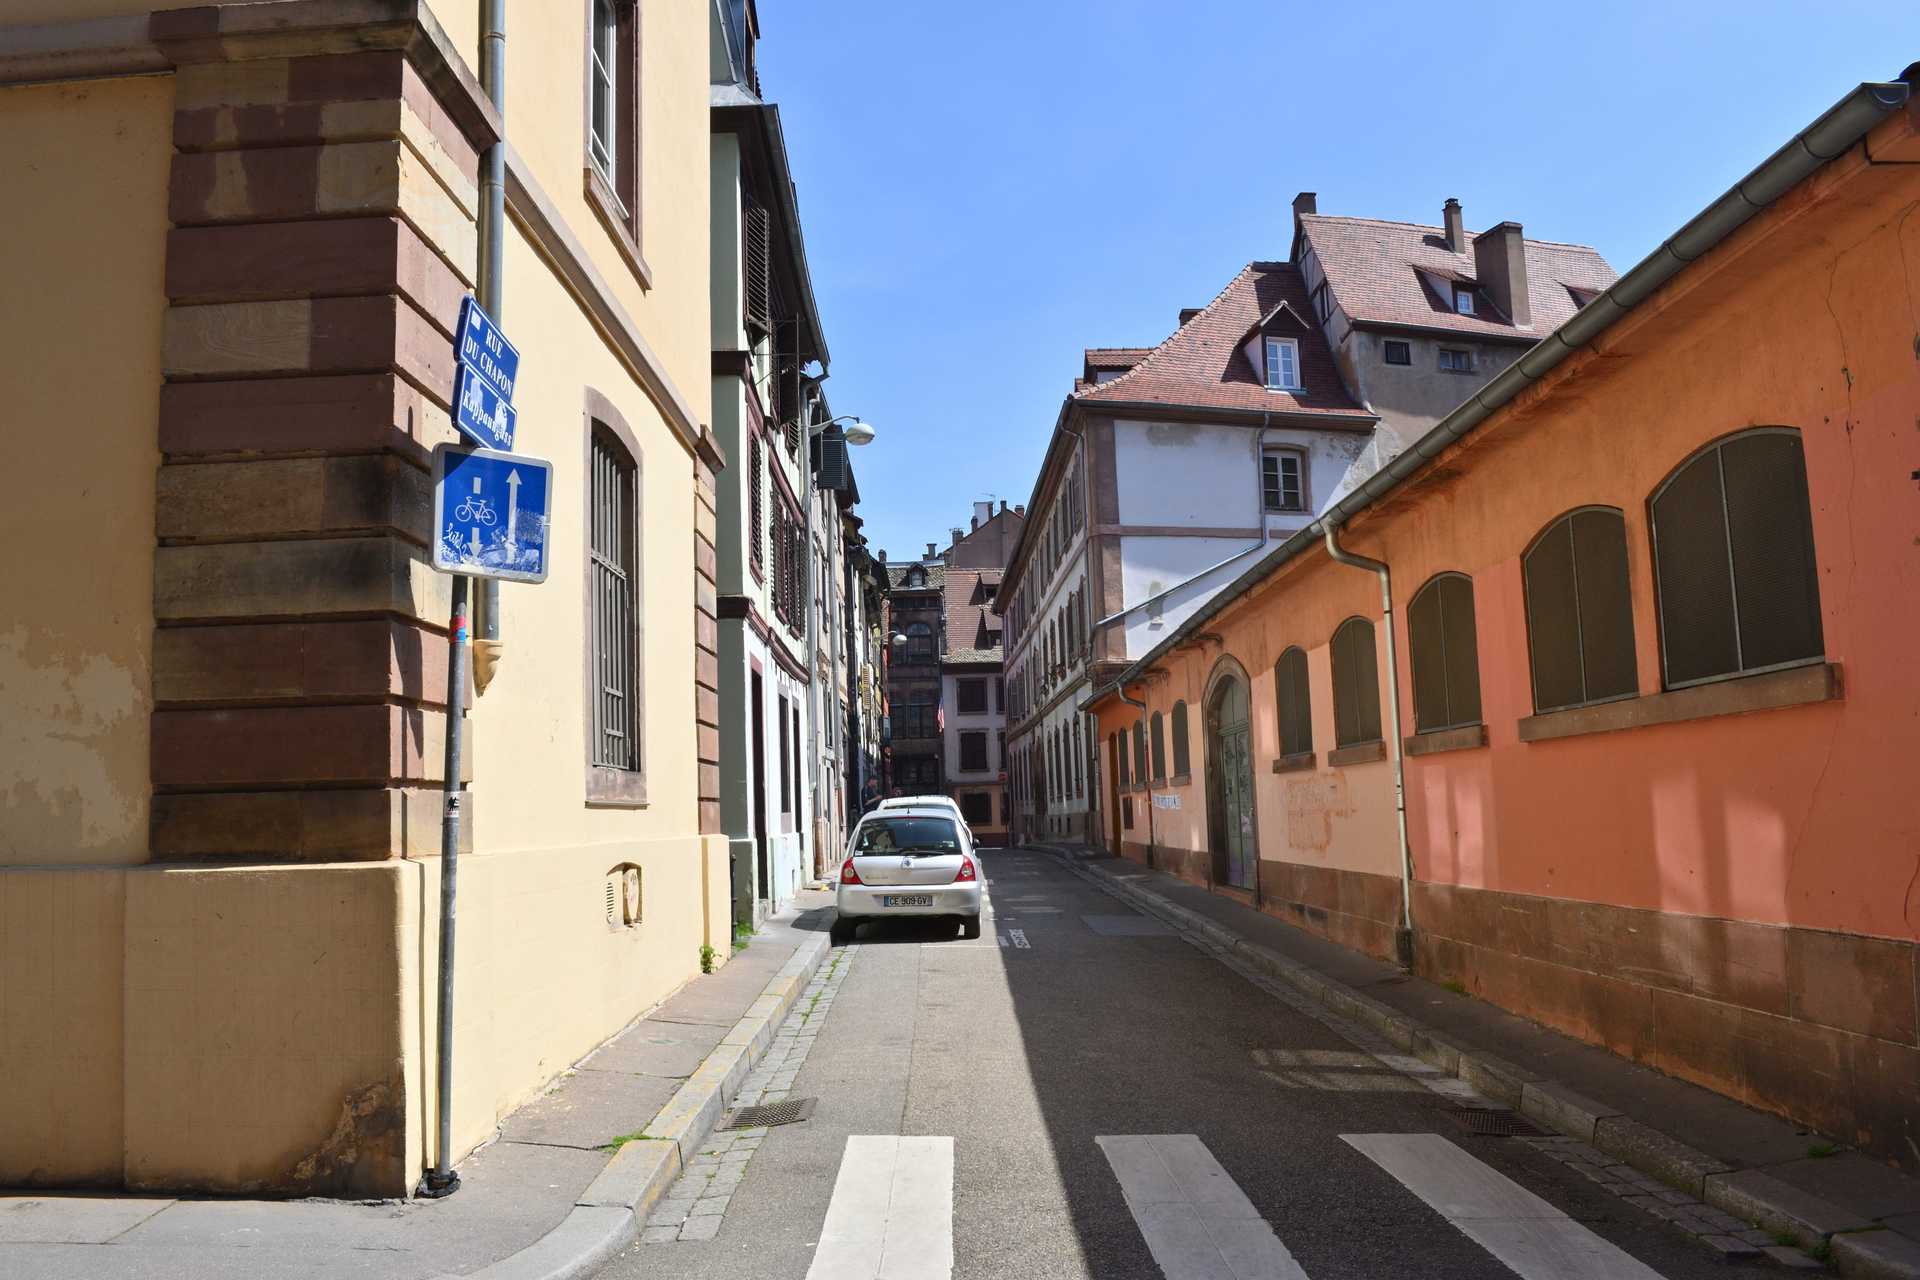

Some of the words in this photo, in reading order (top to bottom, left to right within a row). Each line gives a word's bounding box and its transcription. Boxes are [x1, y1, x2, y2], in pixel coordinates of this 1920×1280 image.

[485, 328, 503, 359] RUE
[466, 335, 478, 360] DU
[480, 352, 512, 396] CHAPON
[889, 896, 900, 906] CE
